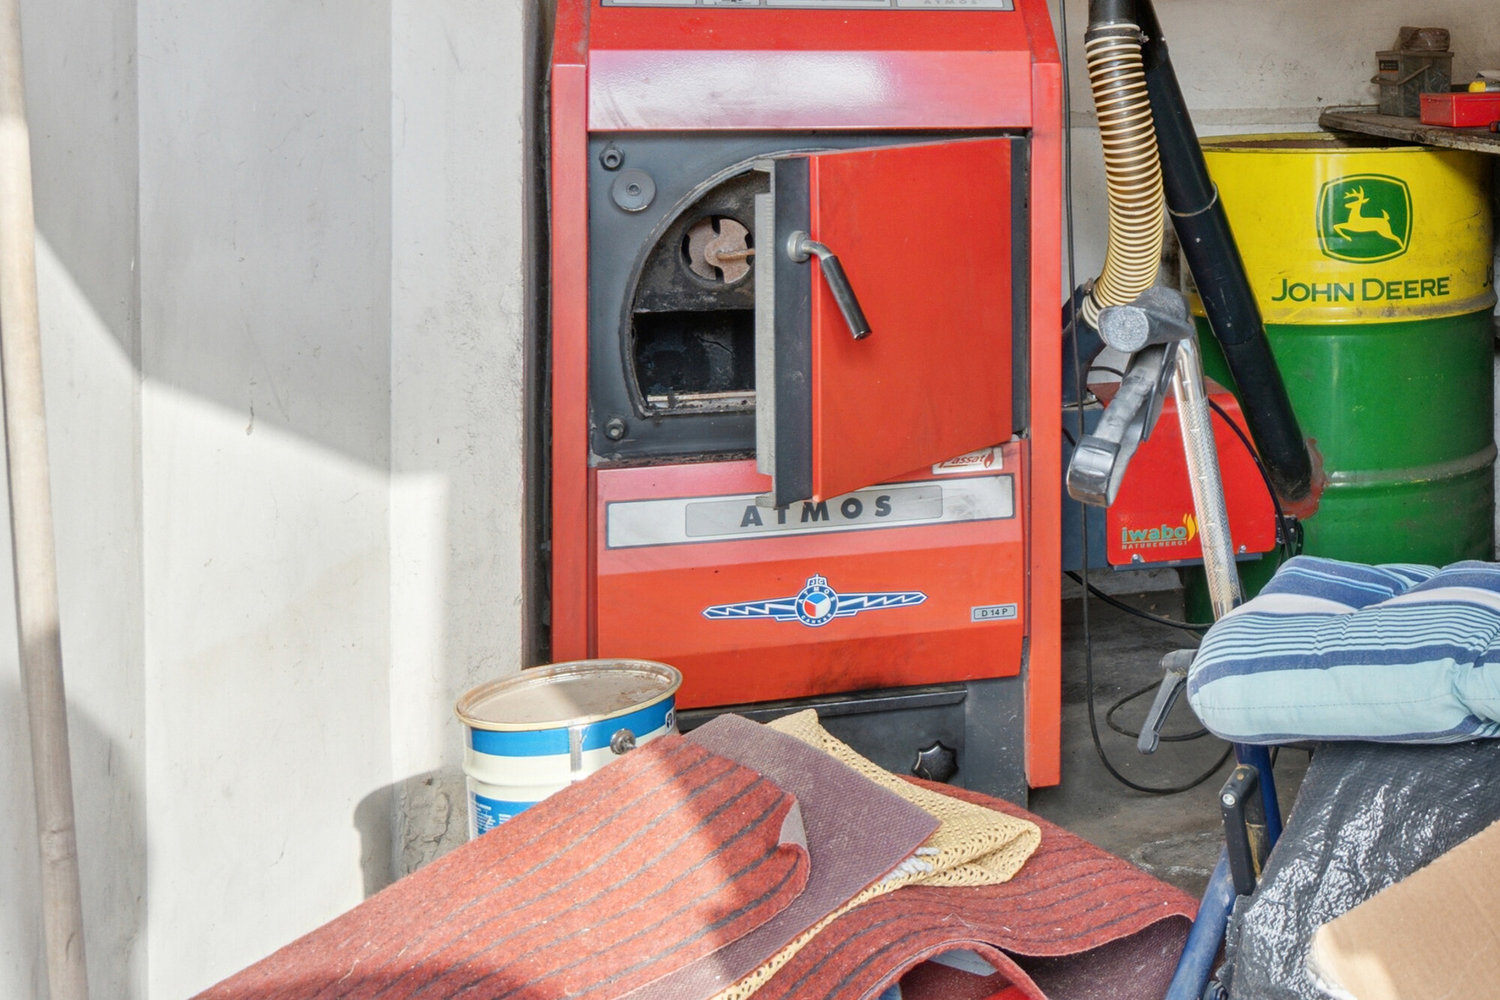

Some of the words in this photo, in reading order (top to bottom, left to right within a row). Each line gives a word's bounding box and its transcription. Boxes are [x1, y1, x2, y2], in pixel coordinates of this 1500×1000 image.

[1271, 278, 1355, 302] JOHN
[1361, 276, 1450, 301] DEERE
[740, 495, 892, 528] ATMOS
[1121, 524, 1187, 543] iwabo
[981, 609, 988, 617] D
[991, 608, 1000, 616] 14
[1001, 607, 1008, 615] P
